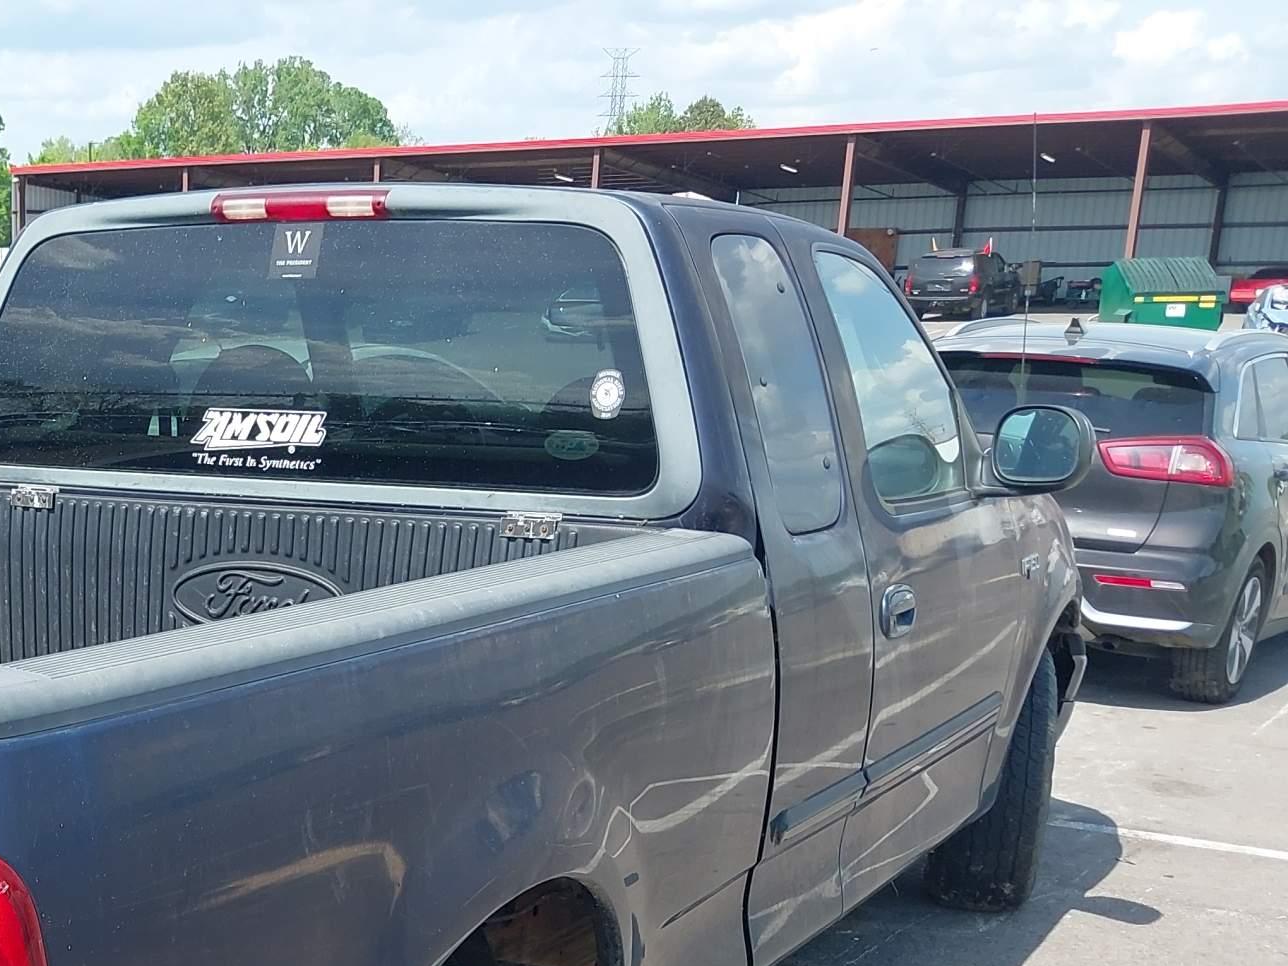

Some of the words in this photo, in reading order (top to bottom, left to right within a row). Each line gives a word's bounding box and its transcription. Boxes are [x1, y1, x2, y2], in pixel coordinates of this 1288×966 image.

[285, 230, 312, 255] W
[192, 408, 327, 450] AMSOIL
[218, 454, 244, 467] First
[245, 456, 257, 468] In
